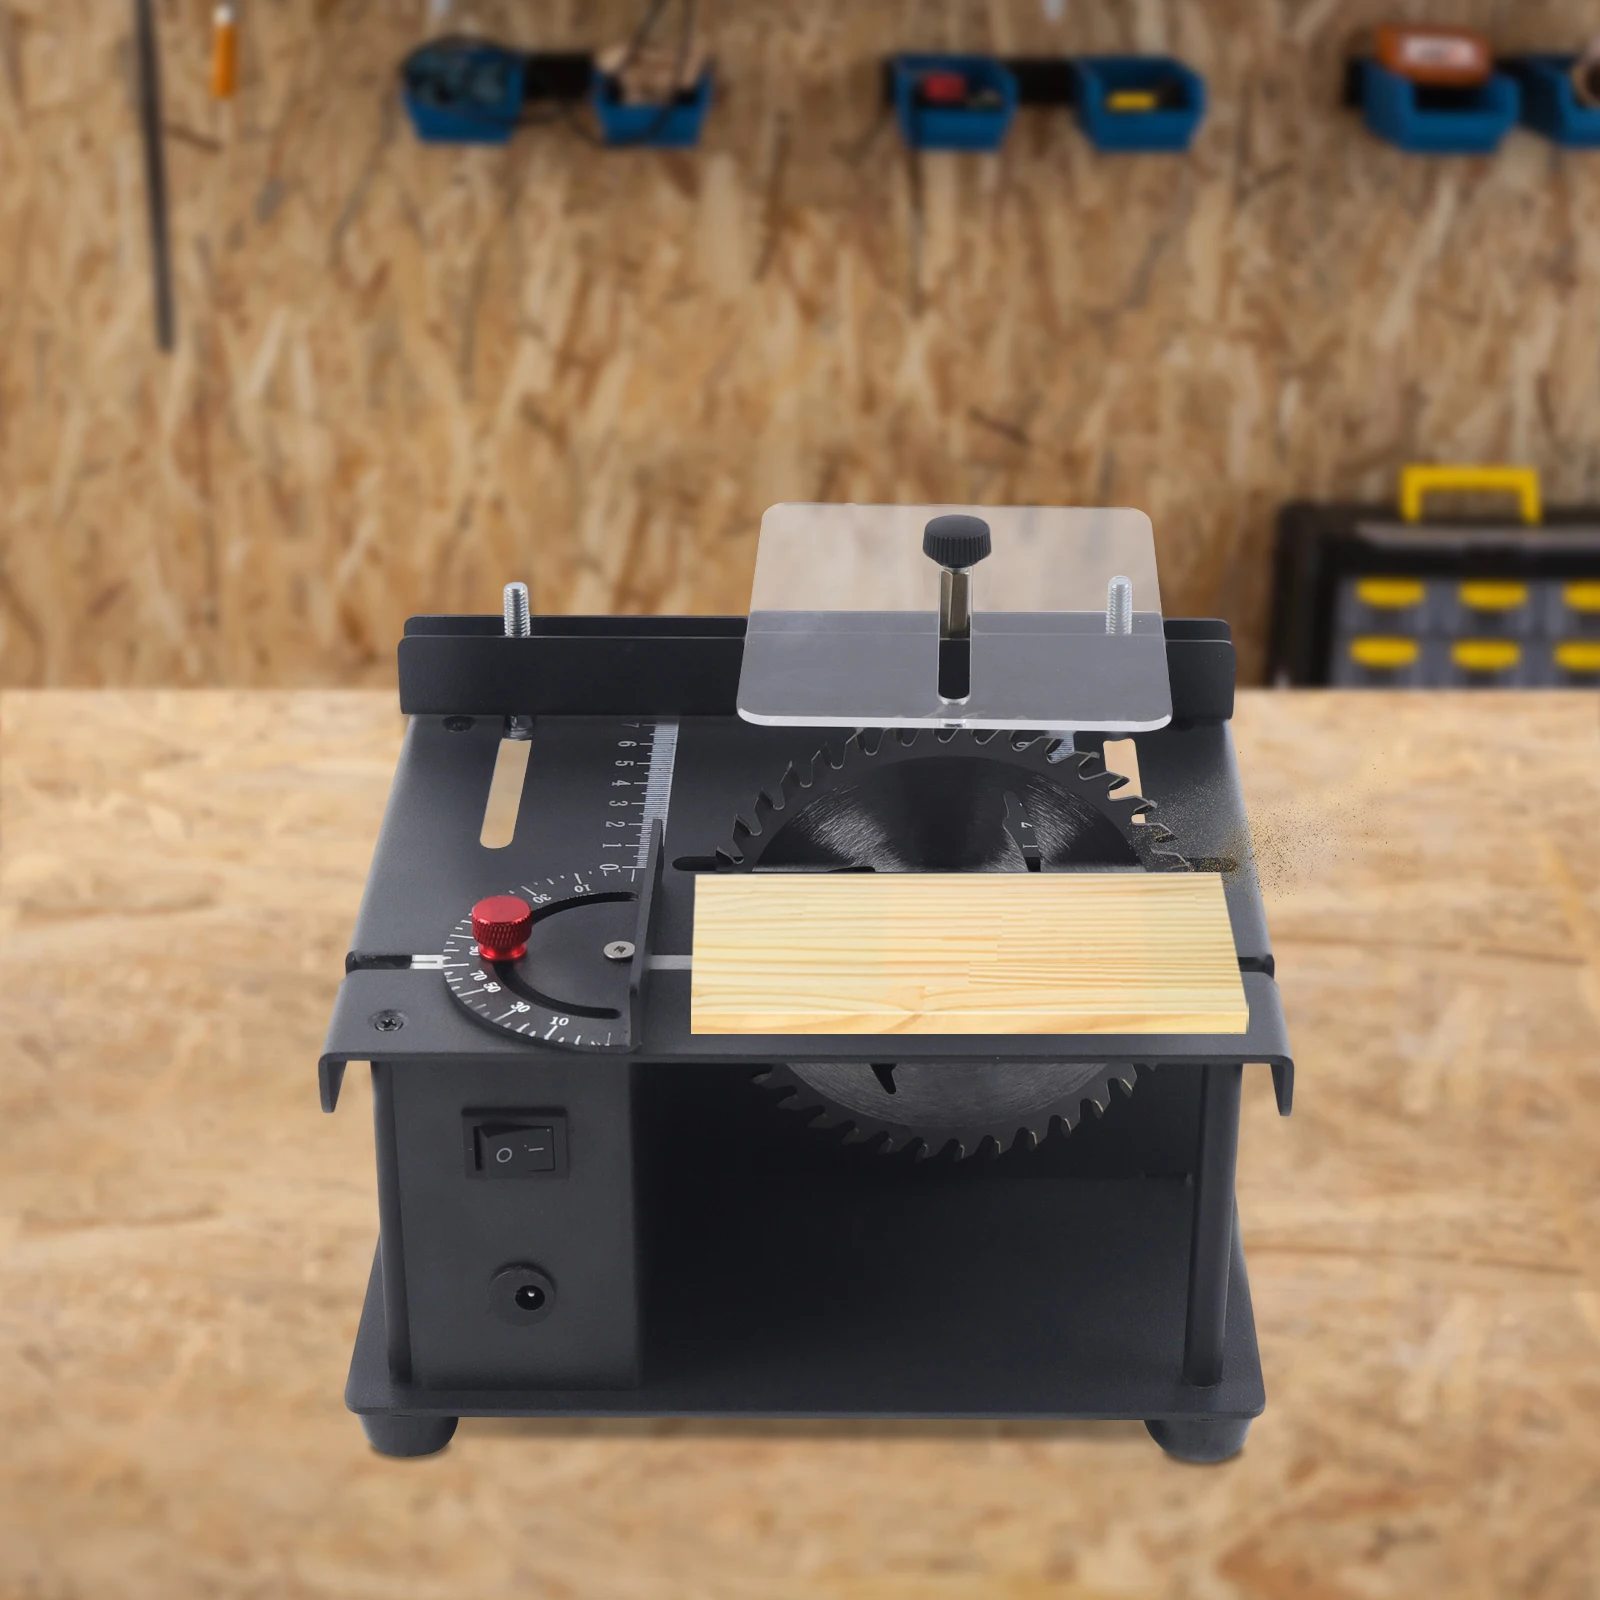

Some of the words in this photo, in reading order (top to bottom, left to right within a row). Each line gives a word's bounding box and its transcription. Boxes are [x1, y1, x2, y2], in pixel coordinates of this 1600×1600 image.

[611, 779, 632, 787] 4
[605, 820, 626, 828] 2
[599, 863, 620, 871] 0
[573, 884, 592, 893] 10
[532, 893, 552, 904] 30
[469, 969, 488, 981] 70
[483, 981, 502, 993] 50
[510, 1001, 531, 1013] 30
[549, 1016, 570, 1027] 10
